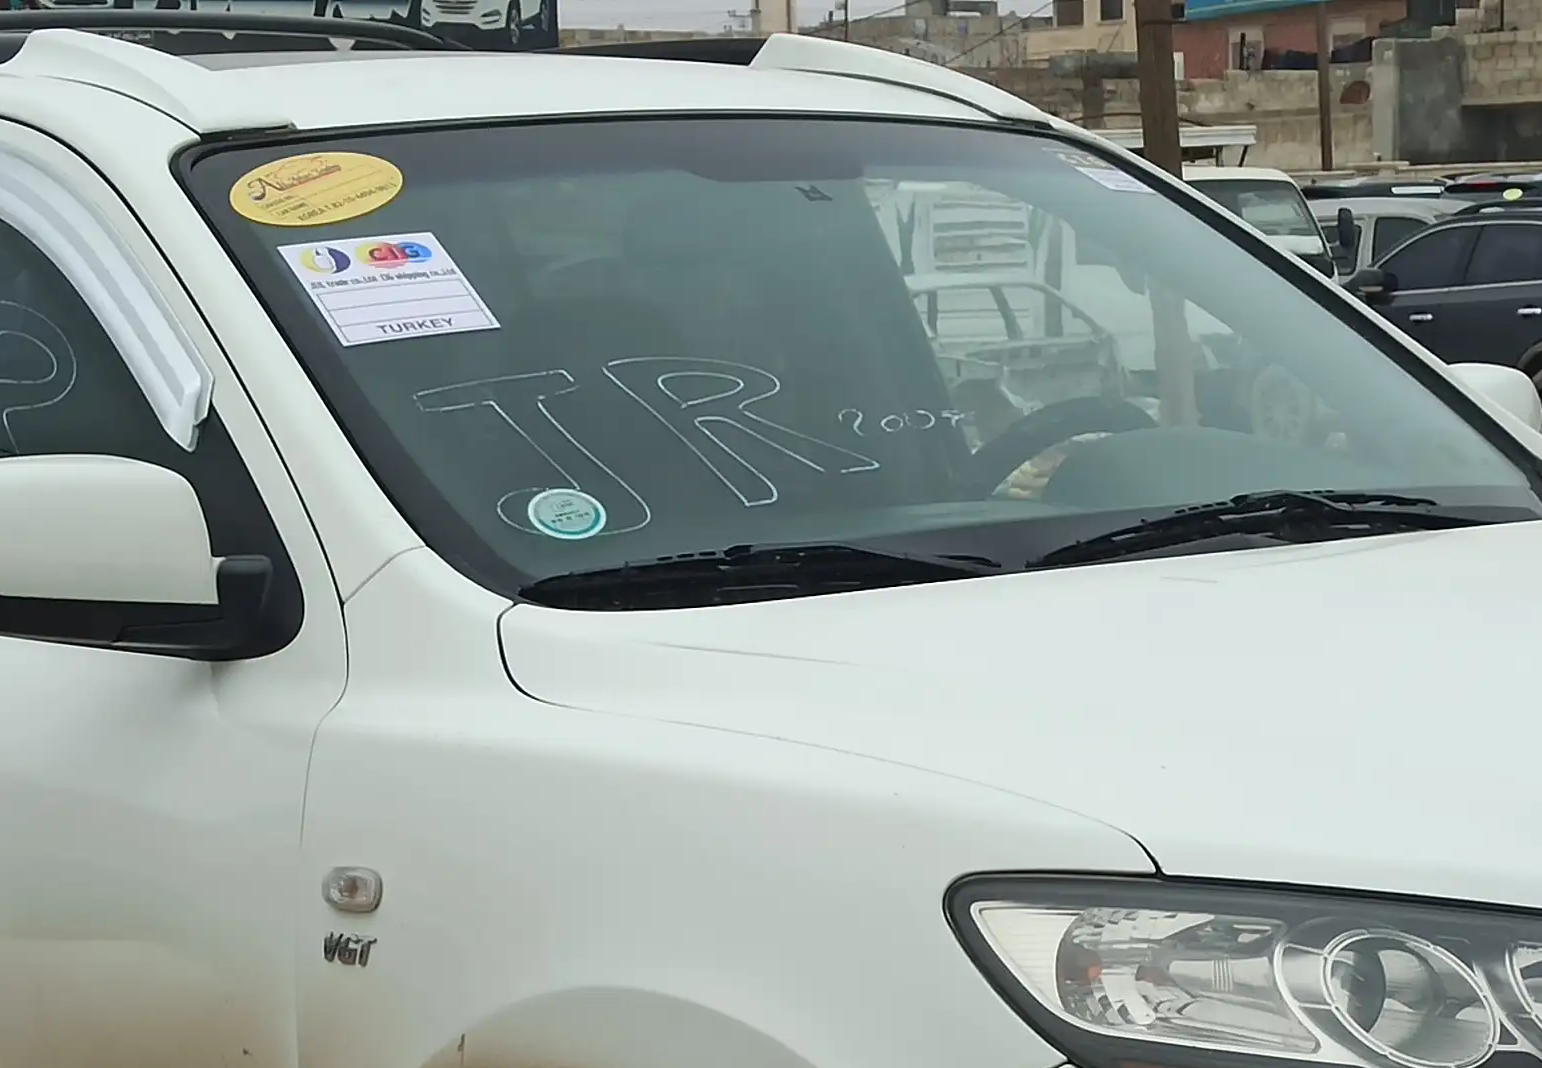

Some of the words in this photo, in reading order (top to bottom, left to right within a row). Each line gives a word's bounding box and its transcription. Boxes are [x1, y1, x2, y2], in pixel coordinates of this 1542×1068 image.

[377, 317, 456, 335] TURKEY
[414, 356, 880, 535] JR
[323, 931, 378, 967] VGT
